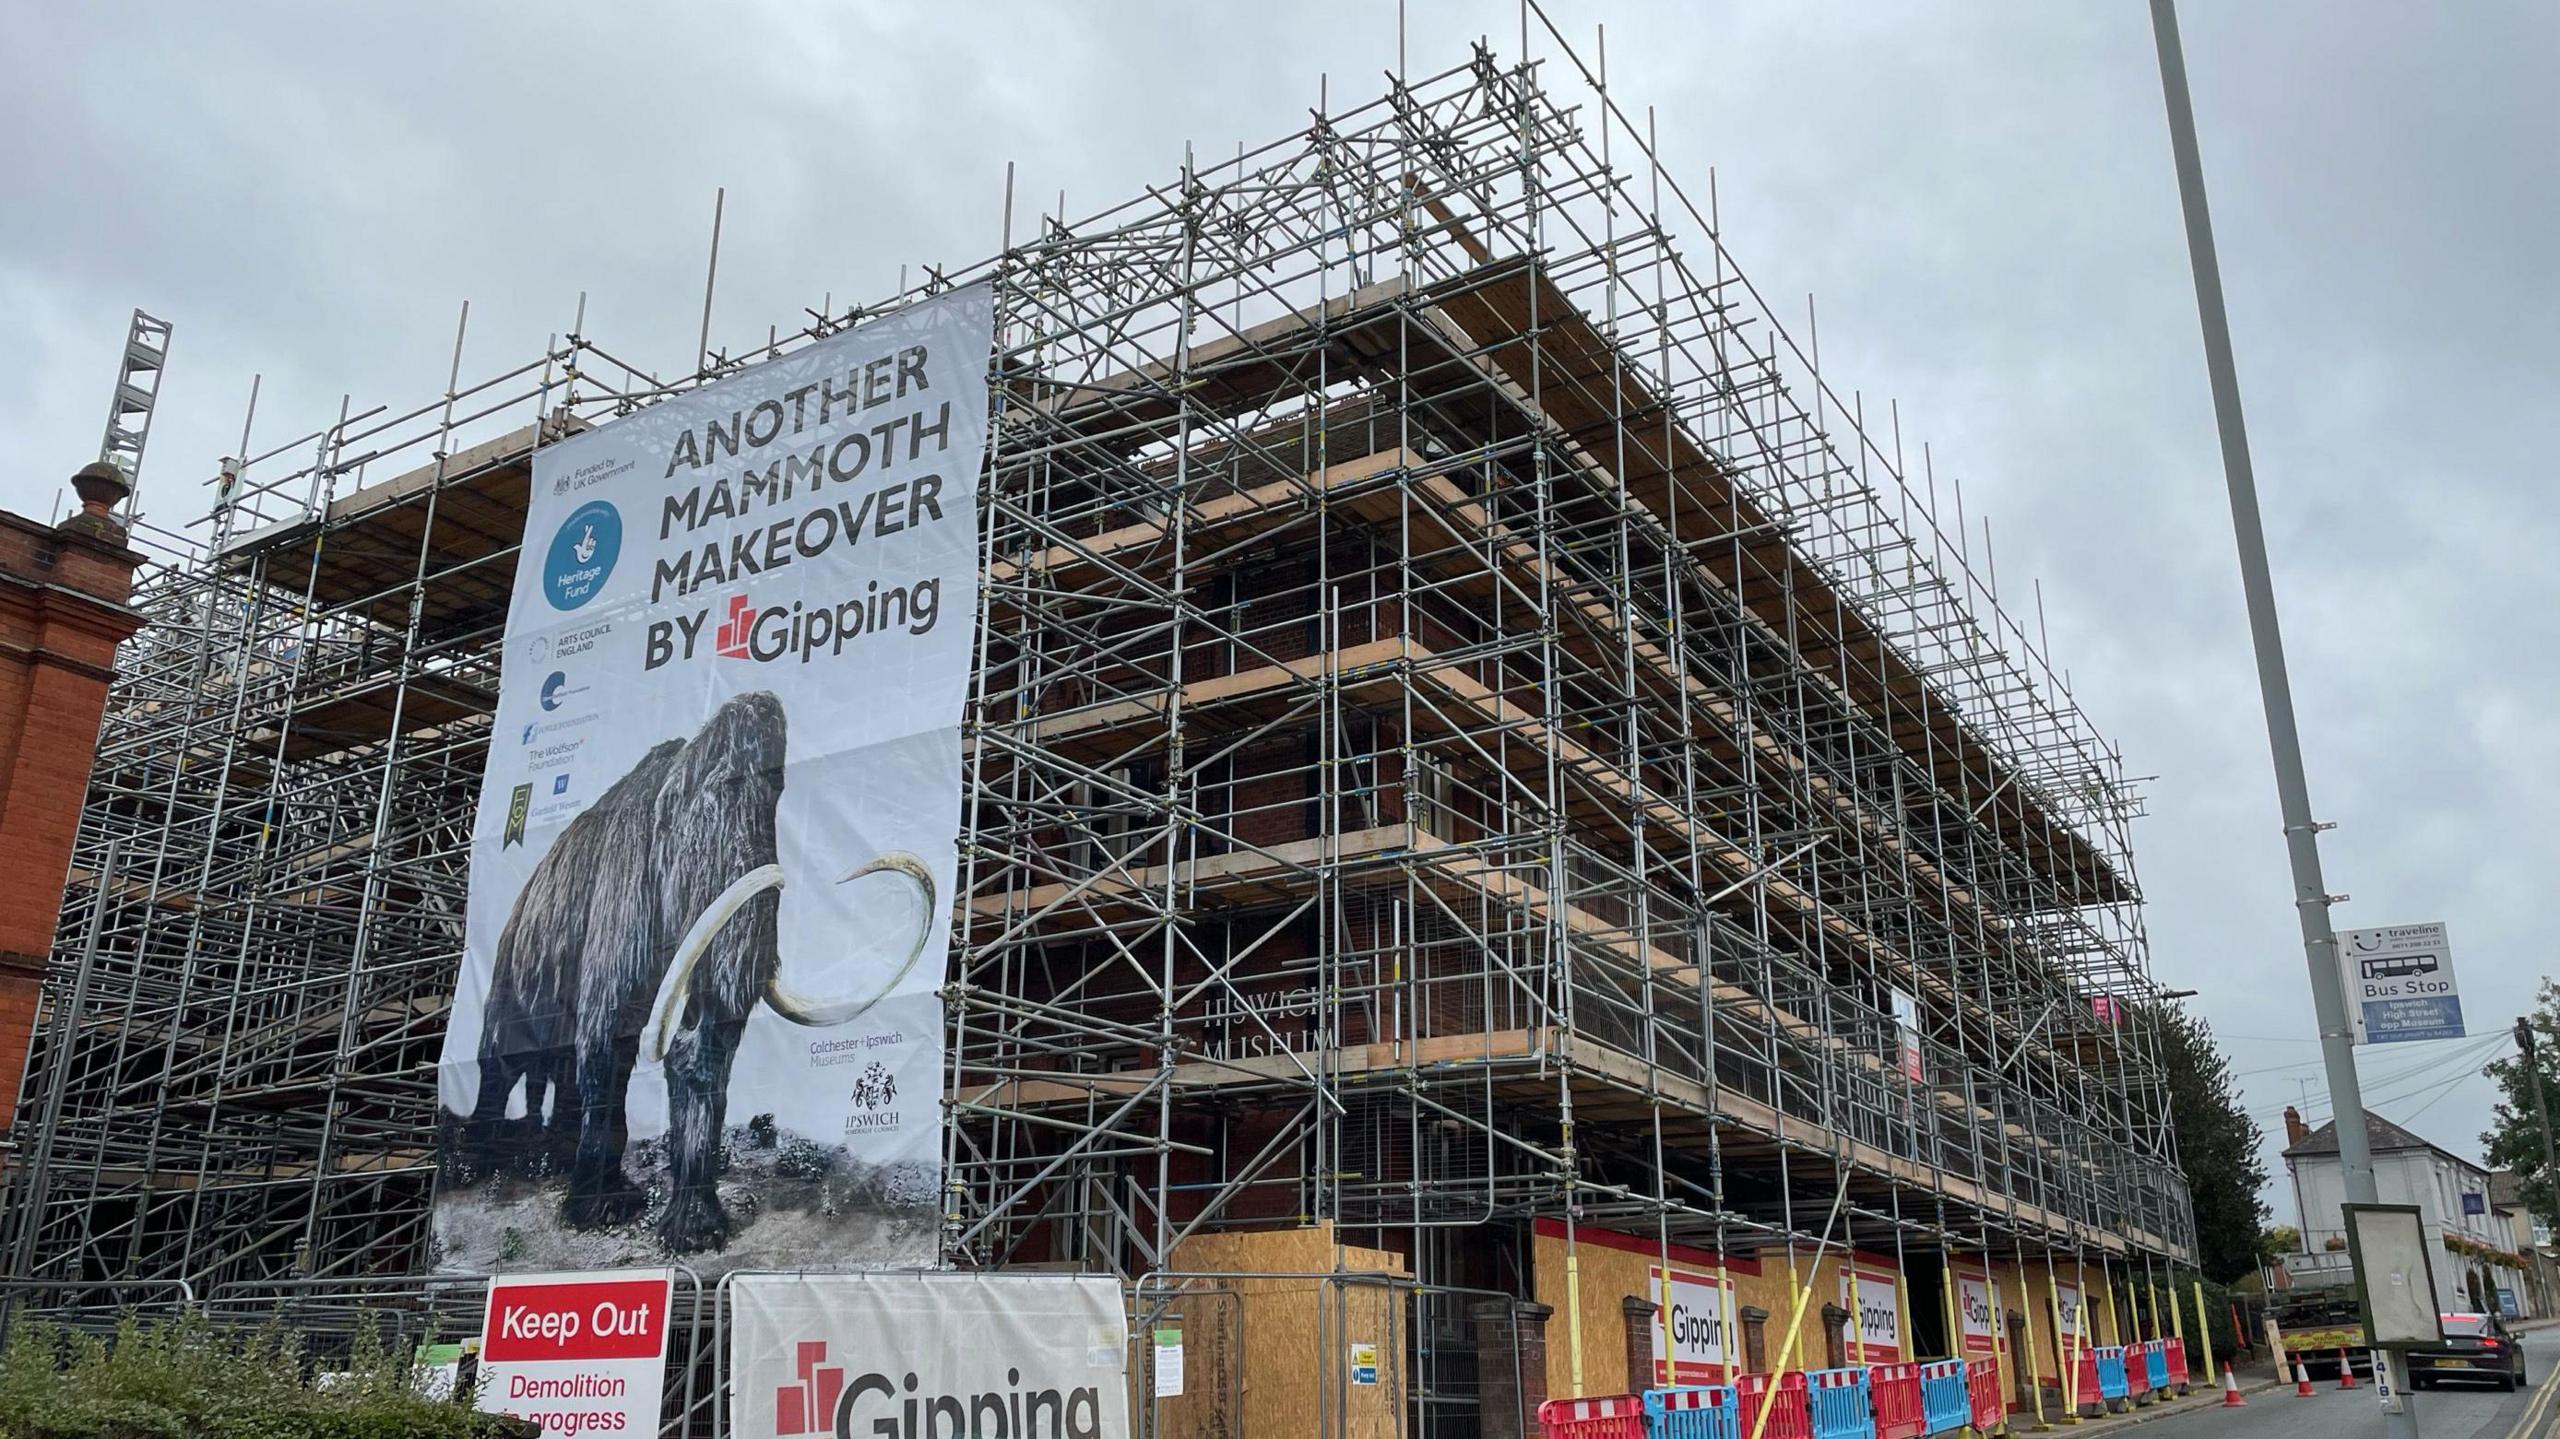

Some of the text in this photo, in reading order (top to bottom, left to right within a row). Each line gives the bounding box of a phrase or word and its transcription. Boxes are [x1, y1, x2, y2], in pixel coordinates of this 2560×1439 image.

[664, 345, 929, 478] ANOTHER
[573, 458, 616, 480] Funded by
[573, 460, 636, 491] UK Government
[660, 401, 950, 540] MAMMOTH
[651, 474, 943, 604] MAKEOVER
[557, 566, 601, 587] Heritage
[564, 583, 590, 600] Fund
[645, 577, 940, 671] BY Gipping
[556, 640, 594, 659] ENGLAND
[558, 633, 578, 647] ARTS
[529, 741, 580, 761] The Wolfson
[2388, 925, 2440, 938] traveline
[2364, 980, 2449, 997] Bus Stop
[2382, 1008, 2439, 1020] High Street
[2388, 999, 2428, 1010] Ipswich
[2380, 1018, 2445, 1030] opp Museum
[810, 1053, 856, 1068] Museums
[845, 1111, 899, 1128] IPSWICH
[1969, 1295, 2002, 1332] Gippg
[501, 1301, 650, 1347] Keep Out
[509, 1373, 626, 1399] Demolition
